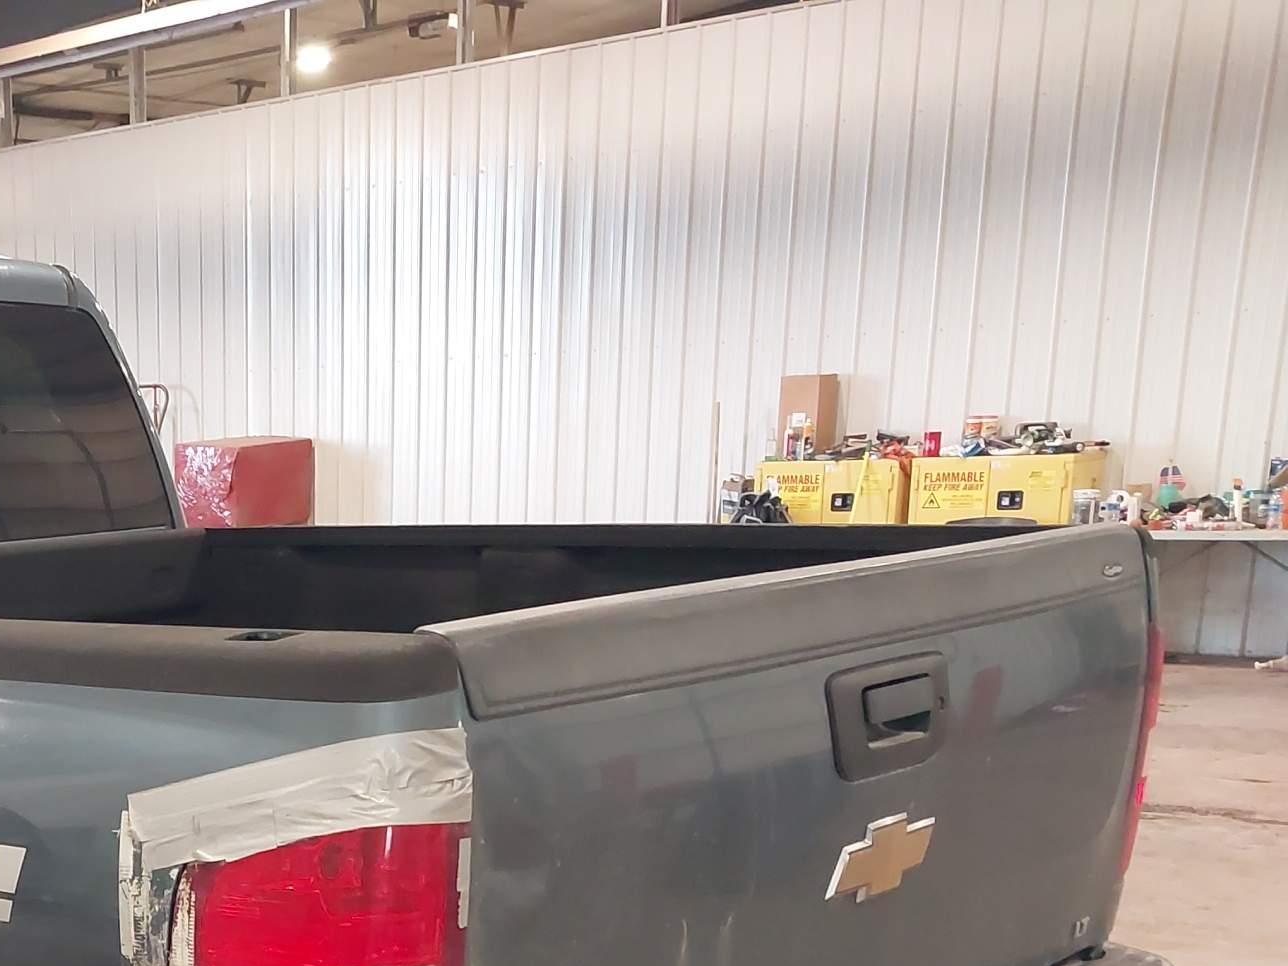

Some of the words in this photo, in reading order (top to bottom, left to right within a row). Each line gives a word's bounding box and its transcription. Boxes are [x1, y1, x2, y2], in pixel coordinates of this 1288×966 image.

[766, 474, 820, 485] AMMABLE
[924, 471, 985, 483] FLAMMABLE
[784, 485, 799, 493] FIRE
[800, 485, 820, 493] AWAY
[923, 483, 942, 492] KEEP
[944, 483, 961, 492] FIRE
[962, 483, 984, 491] AWAY
